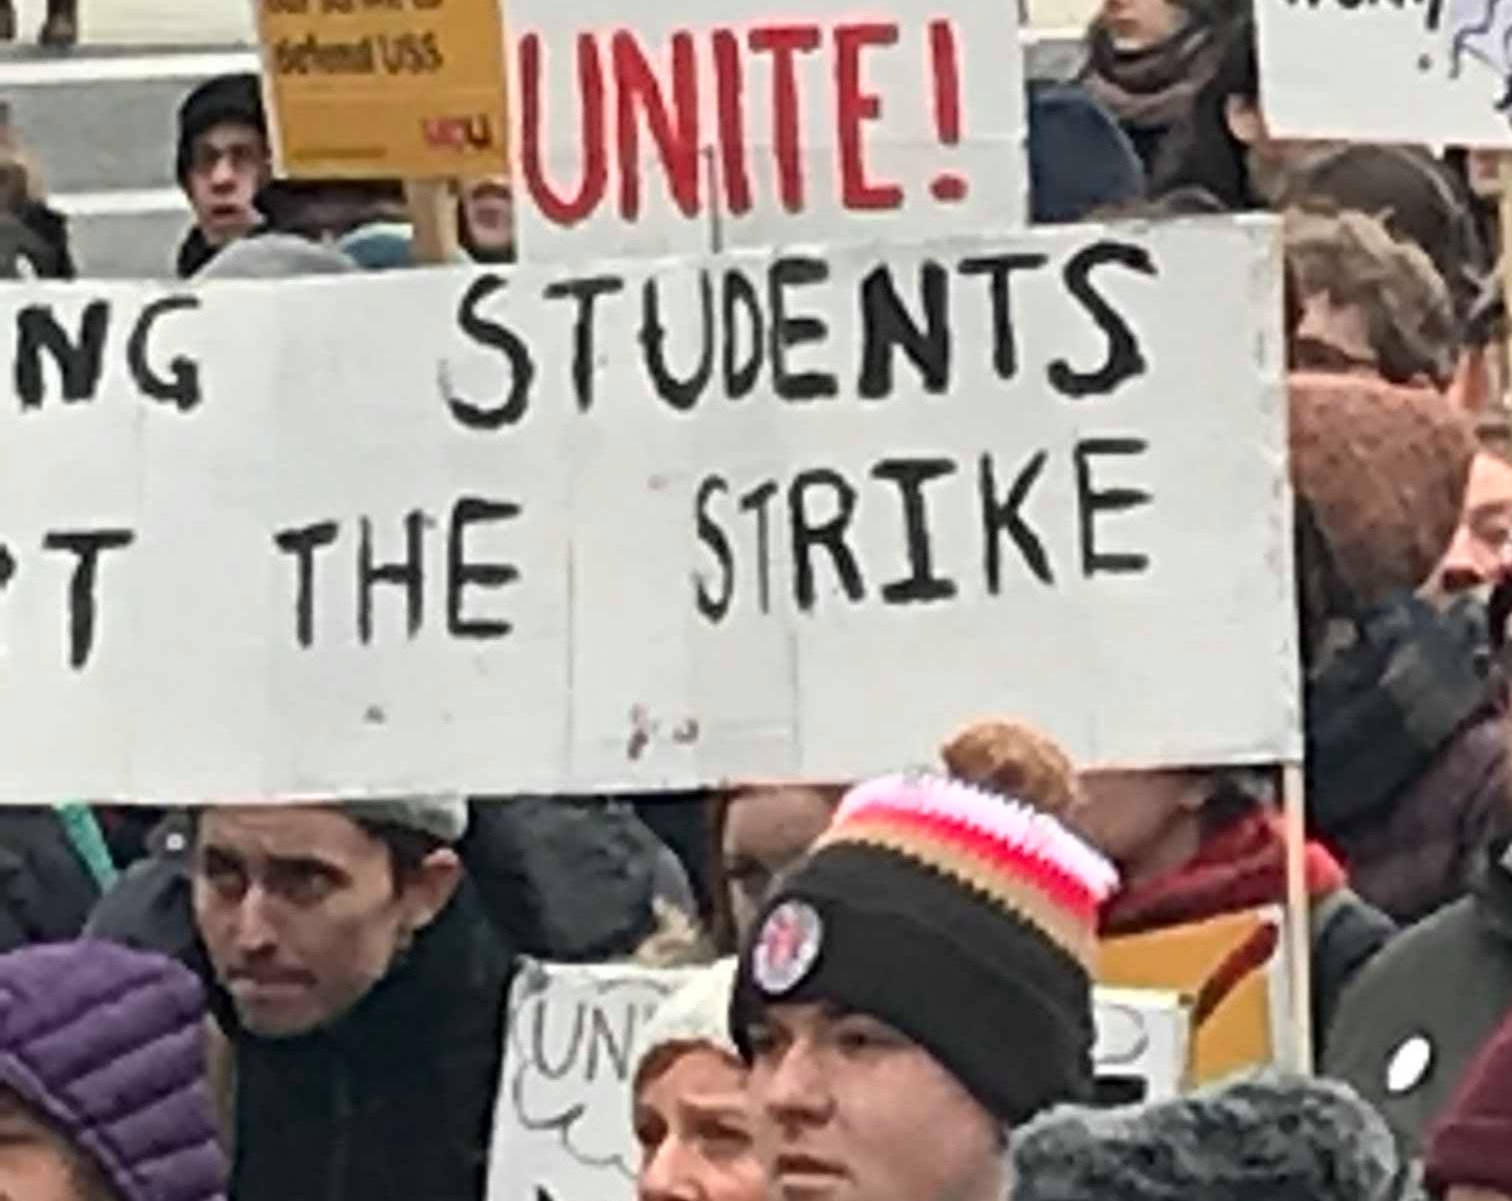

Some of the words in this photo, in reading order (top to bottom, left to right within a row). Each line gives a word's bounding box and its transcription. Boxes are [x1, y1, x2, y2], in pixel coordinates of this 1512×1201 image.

[376, 31, 444, 77] USS
[439, 242, 1159, 430] STUDENTS
[273, 496, 521, 648] THE
[693, 437, 1155, 625] STRIKE
